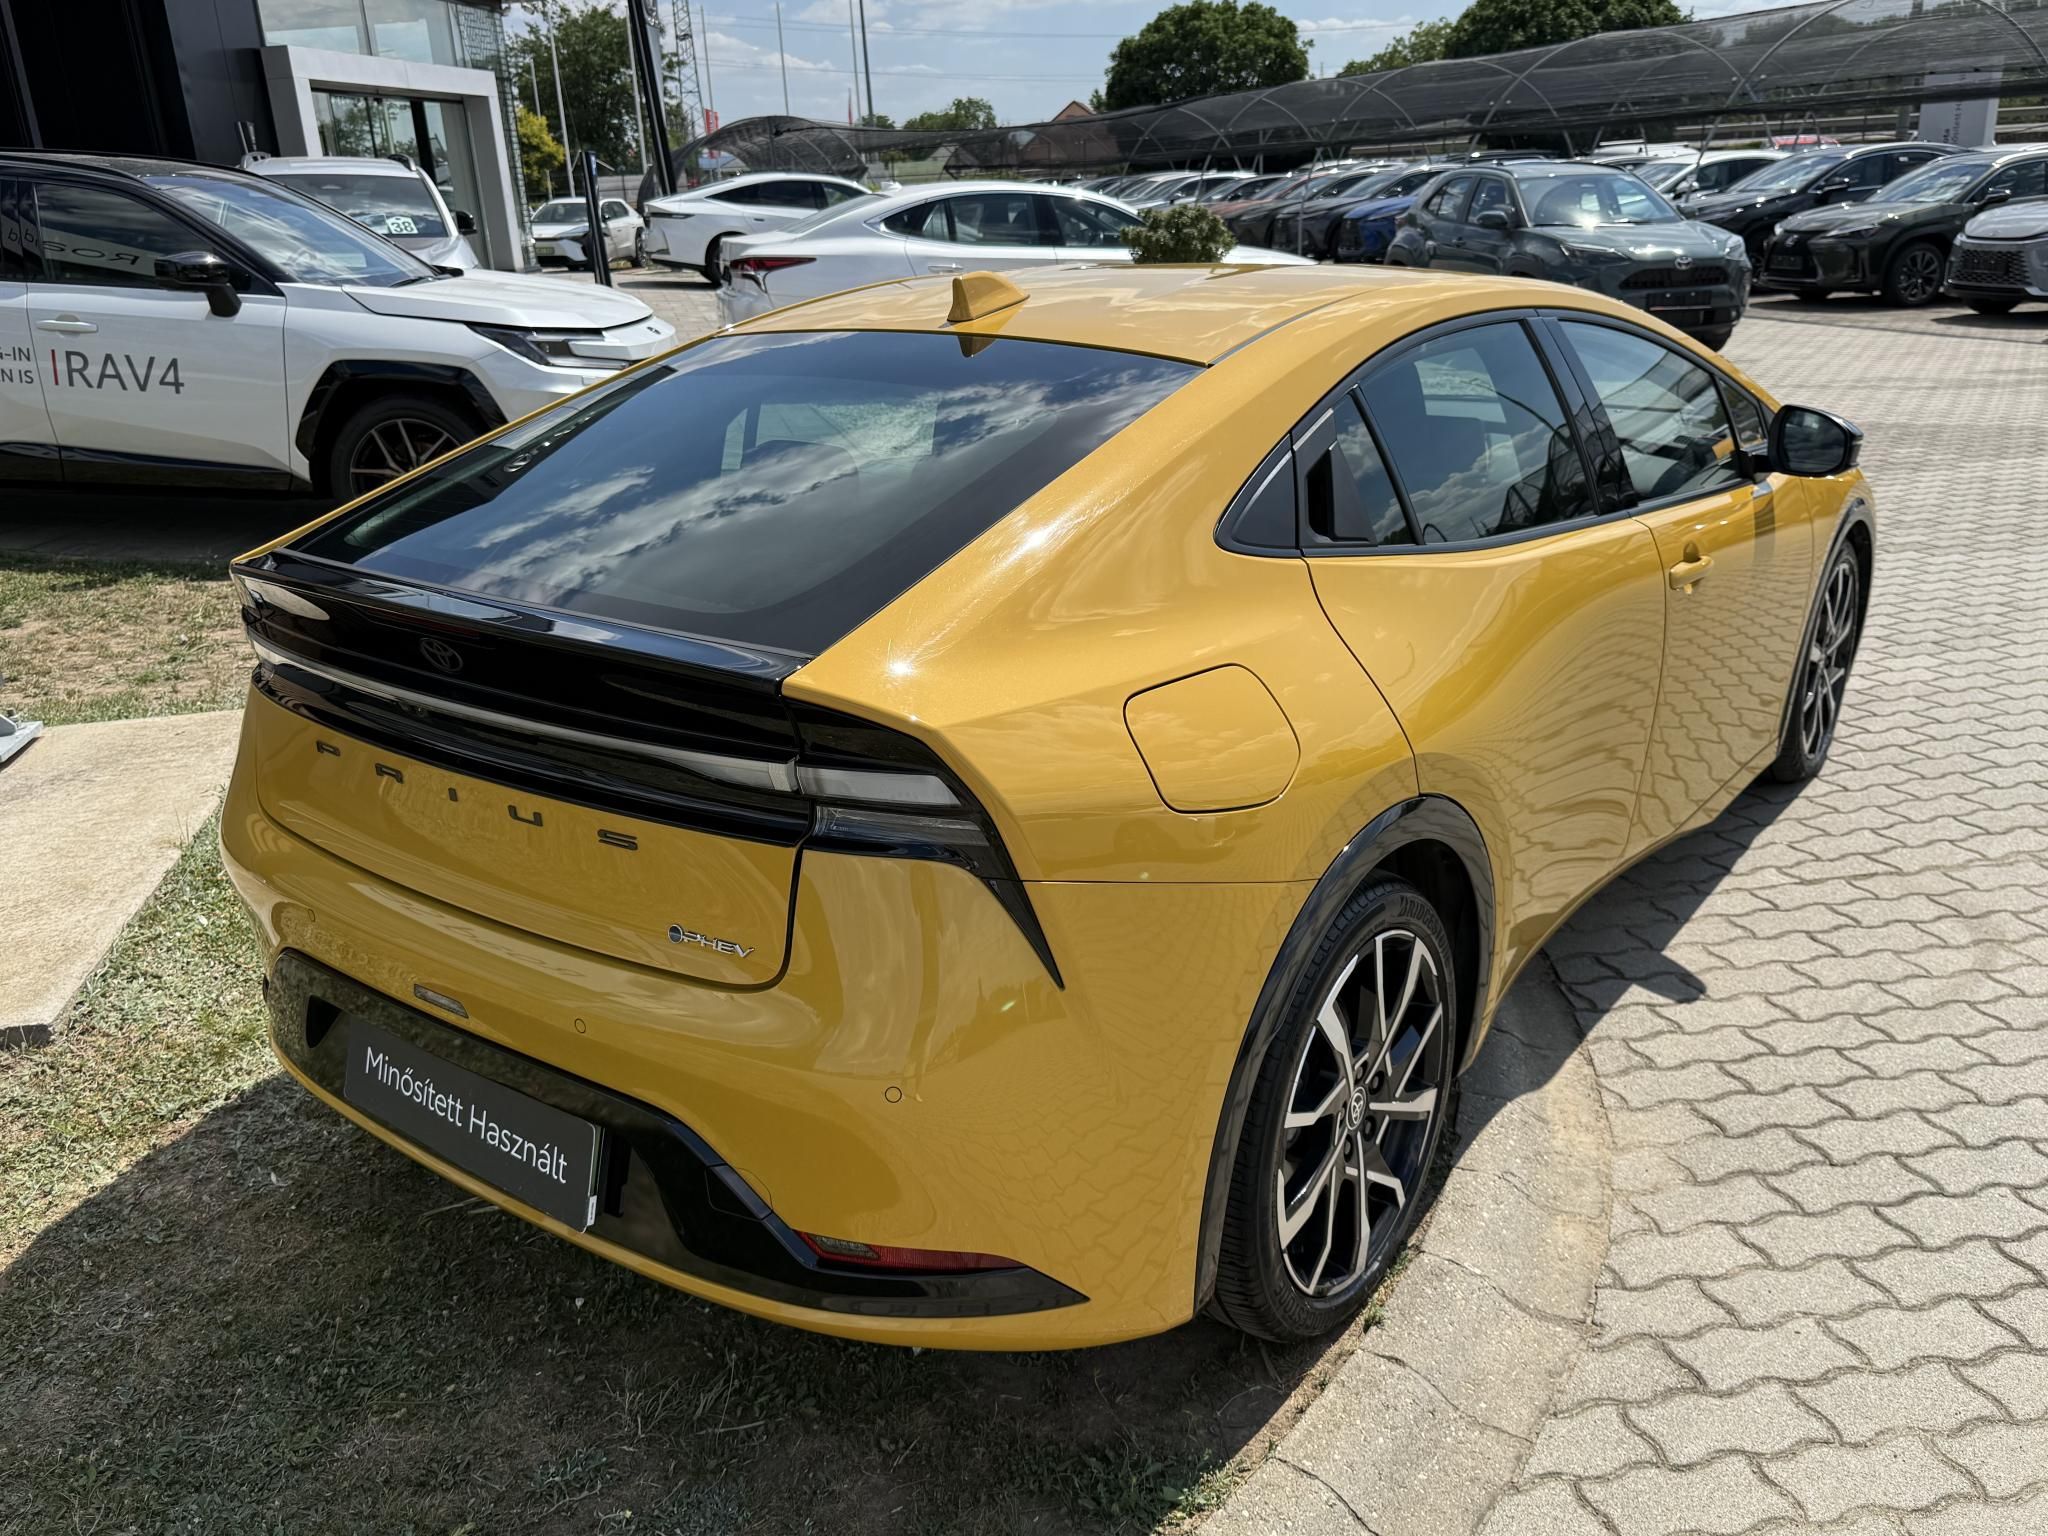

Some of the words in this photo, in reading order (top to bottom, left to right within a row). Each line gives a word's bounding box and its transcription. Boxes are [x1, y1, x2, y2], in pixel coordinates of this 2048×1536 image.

[391, 221, 414, 233] 38
[0, 368, 14, 383] N
[18, 369, 34, 384] IS
[65, 350, 185, 395] RAV4
[316, 739, 638, 851] PRIUS
[682, 930, 755, 958] PHEV
[365, 1046, 463, 1127] Minősített
[469, 1104, 568, 1184] Használt
